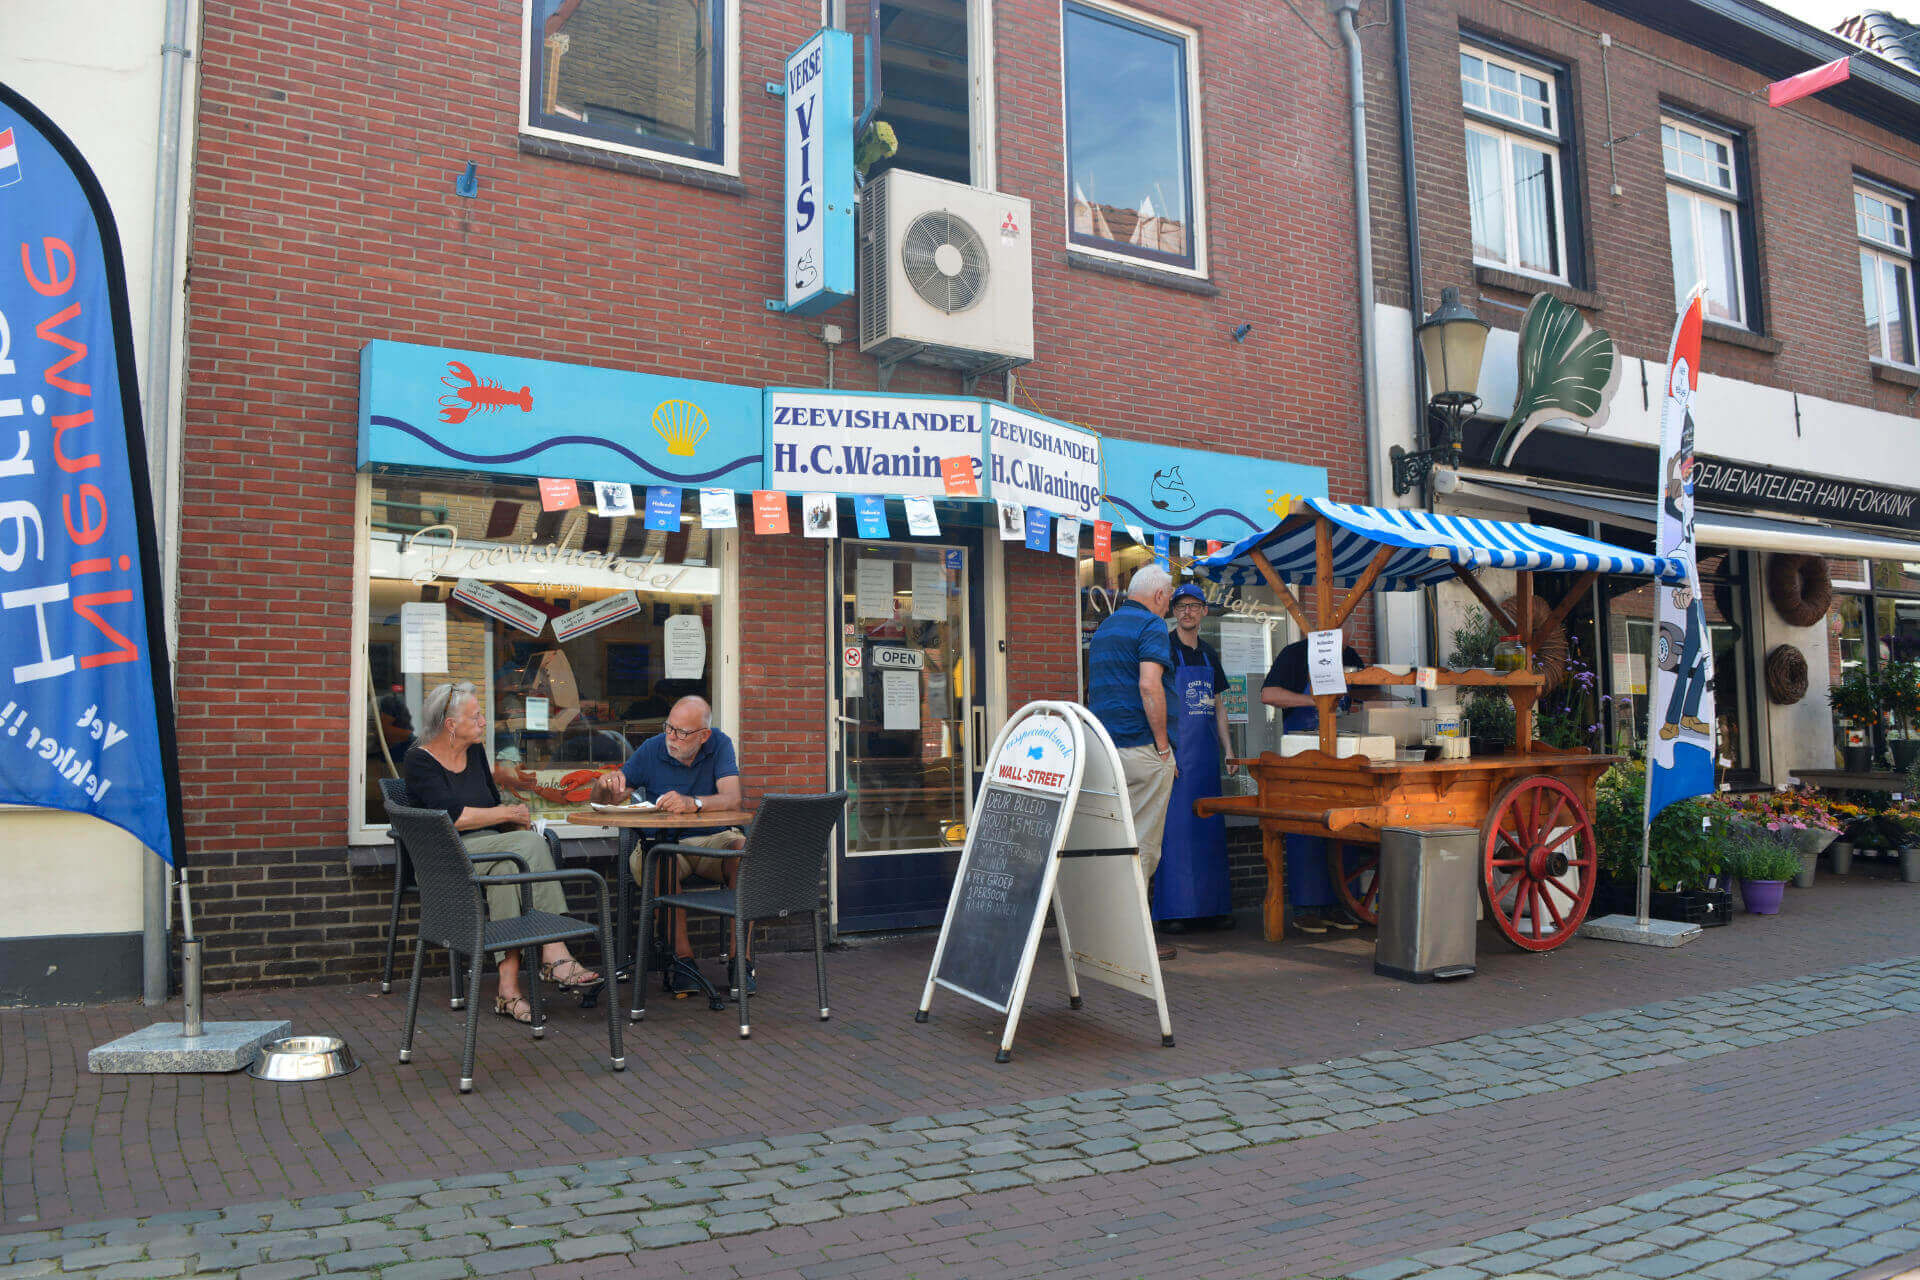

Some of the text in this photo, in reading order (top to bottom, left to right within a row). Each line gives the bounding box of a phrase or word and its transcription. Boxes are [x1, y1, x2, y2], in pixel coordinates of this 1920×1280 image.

[789, 47, 822, 95] VERSE
[795, 93, 816, 233] VIS
[774, 406, 983, 434] ZEEVISHANDEL
[990, 418, 1099, 466] ZEEVISHANDEL
[773, 443, 983, 481] H.C.Wanine
[1690, 461, 1917, 518] OEMENATELIER HAN FOKKINK
[409, 516, 689, 591] Zeevishandel
[882, 651, 916, 665] OPEN
[998, 763, 1066, 788] WALL-STREET
[986, 792, 1048, 816] DEUR BELEID
[1022, 819, 1053, 839] METER
[973, 886, 1009, 903] PERSOON
[986, 874, 1014, 890] GROEP
